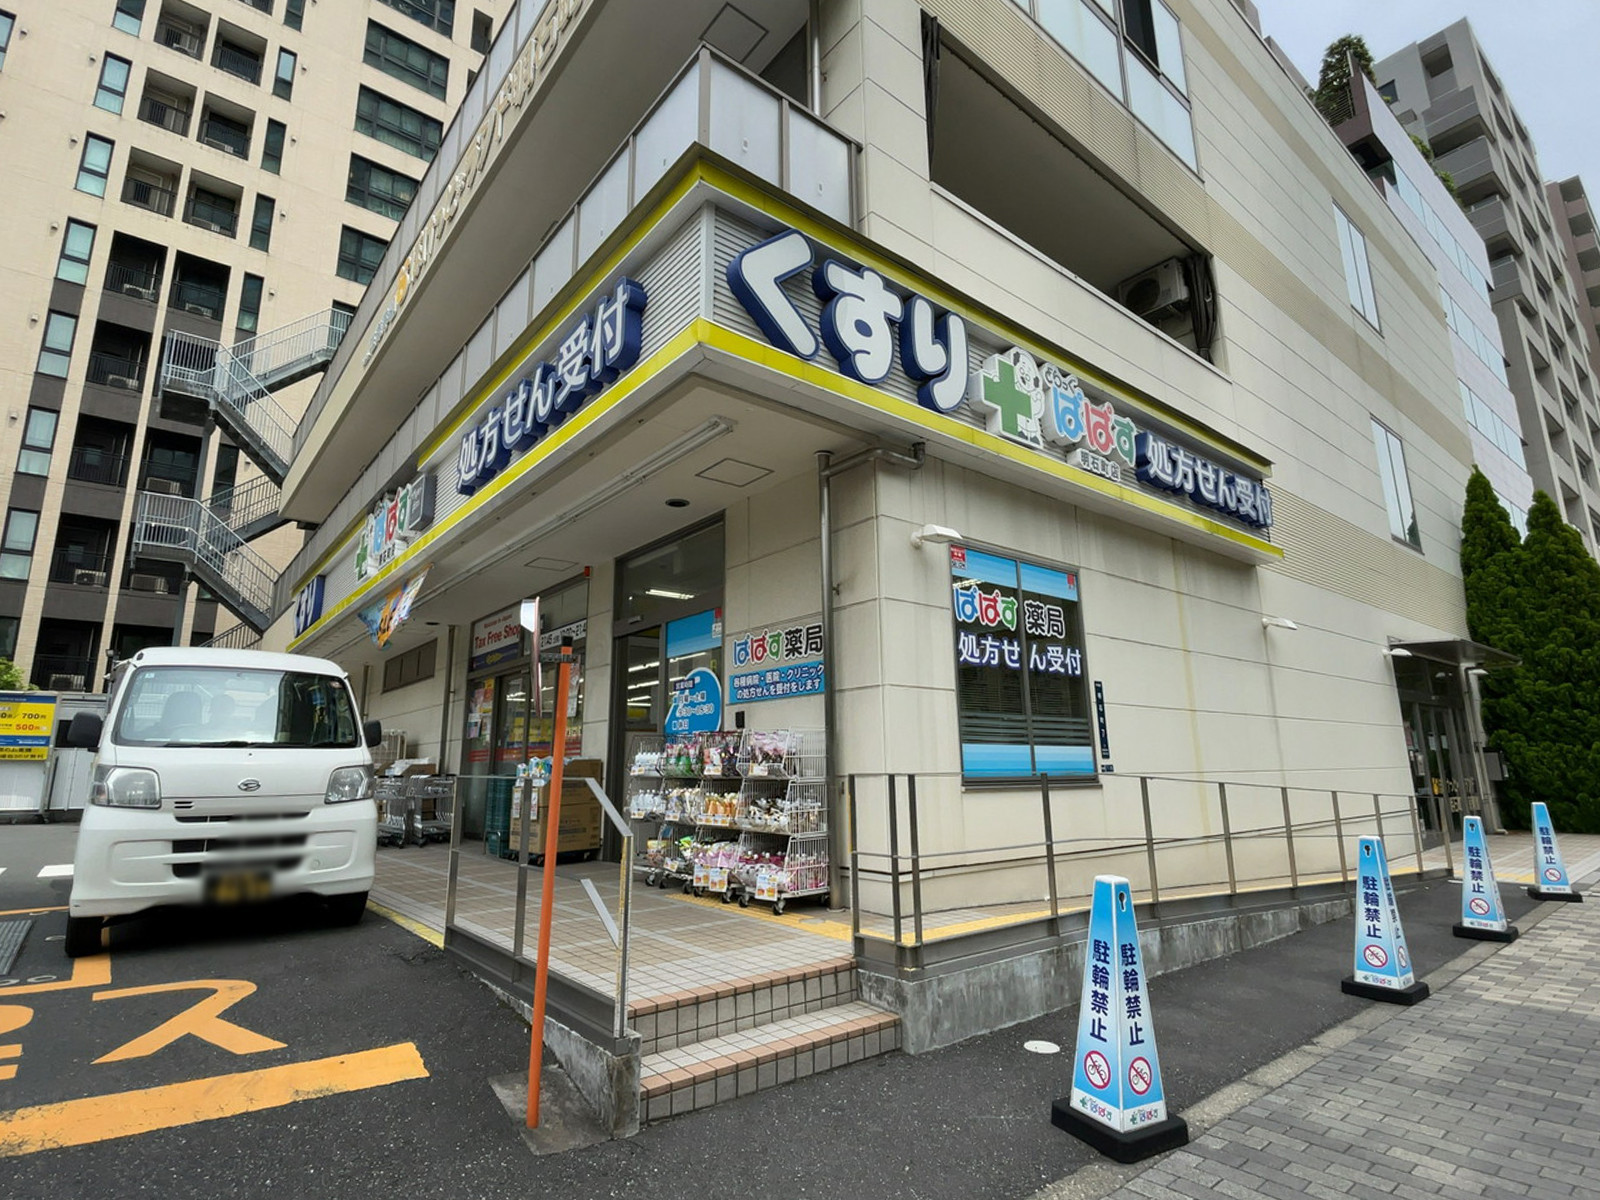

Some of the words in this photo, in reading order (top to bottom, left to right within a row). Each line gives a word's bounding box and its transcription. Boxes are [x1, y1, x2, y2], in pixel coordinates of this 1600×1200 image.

[730, 229, 970, 413] くすり
[458, 283, 630, 491] 処方せん受付
[1052, 389, 1136, 464] ぱぱす
[1079, 450, 1121, 482] 明石町店
[1143, 434, 1273, 529] 処方せん受付
[955, 585, 1065, 639] ぱぱす薬局
[474, 636, 486, 650] Tax
[487, 630, 503, 645] Free
[734, 624, 823, 665] ぱぱす薬局
[958, 632, 1082, 675] 処方せん受付
[737, 679, 821, 699] の処方せんを受付をします
[1468, 846, 1485, 894] 駐輪禁止
[1539, 827, 1557, 865] 駐輪禁止
[1362, 875, 1382, 940] 駐輪禁止
[1089, 939, 1111, 1044] 駐輪禁止
[1120, 943, 1145, 1047] 駐輪禁止
